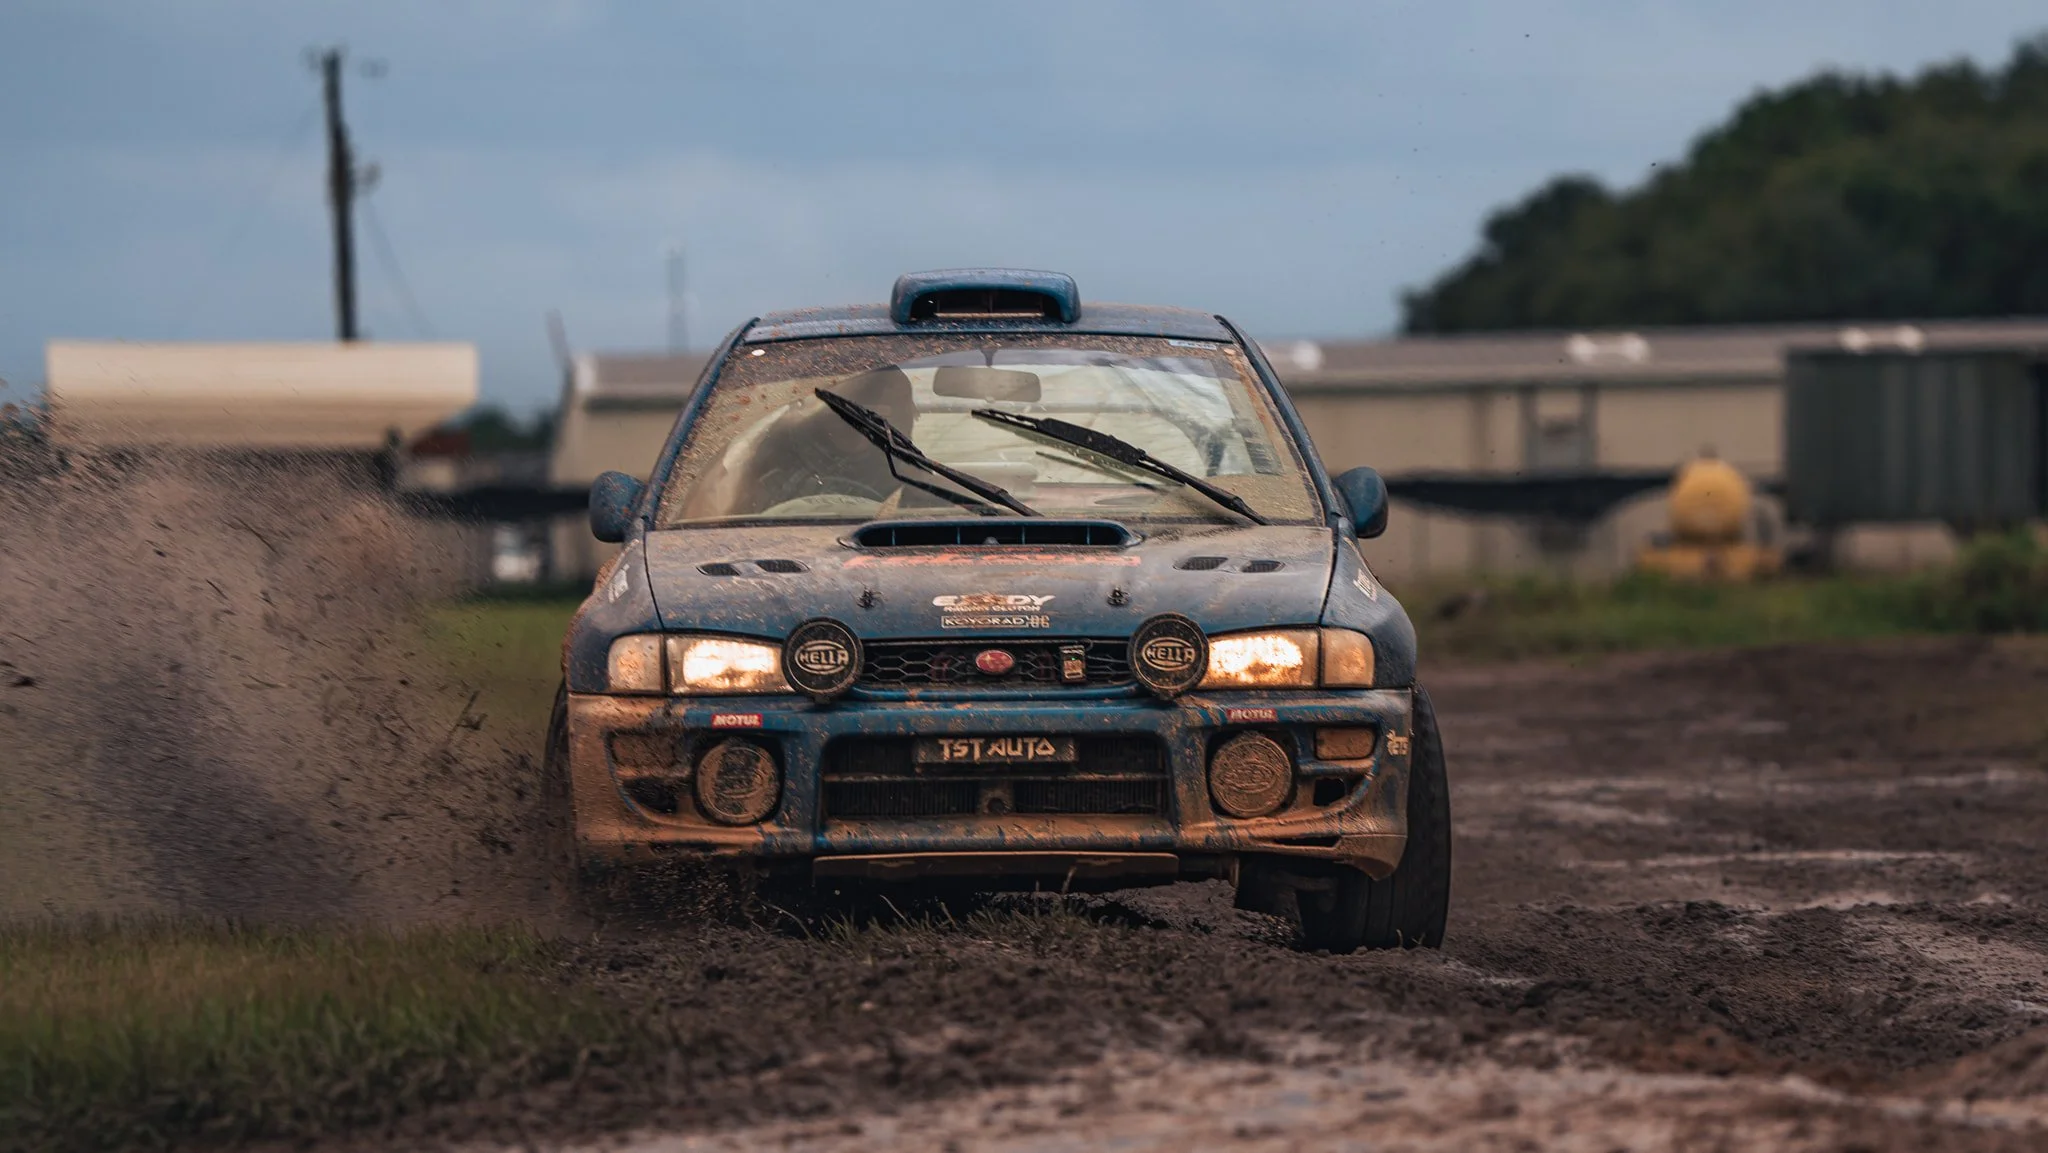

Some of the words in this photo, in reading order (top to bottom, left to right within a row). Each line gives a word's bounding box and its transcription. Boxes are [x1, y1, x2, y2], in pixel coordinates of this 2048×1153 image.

[799, 649, 849, 666] HELLA
[1146, 646, 1196, 663] HELLA
[713, 714, 760, 726] MOTUL
[938, 738, 985, 762] TST
[987, 737, 1056, 761] AUTO
